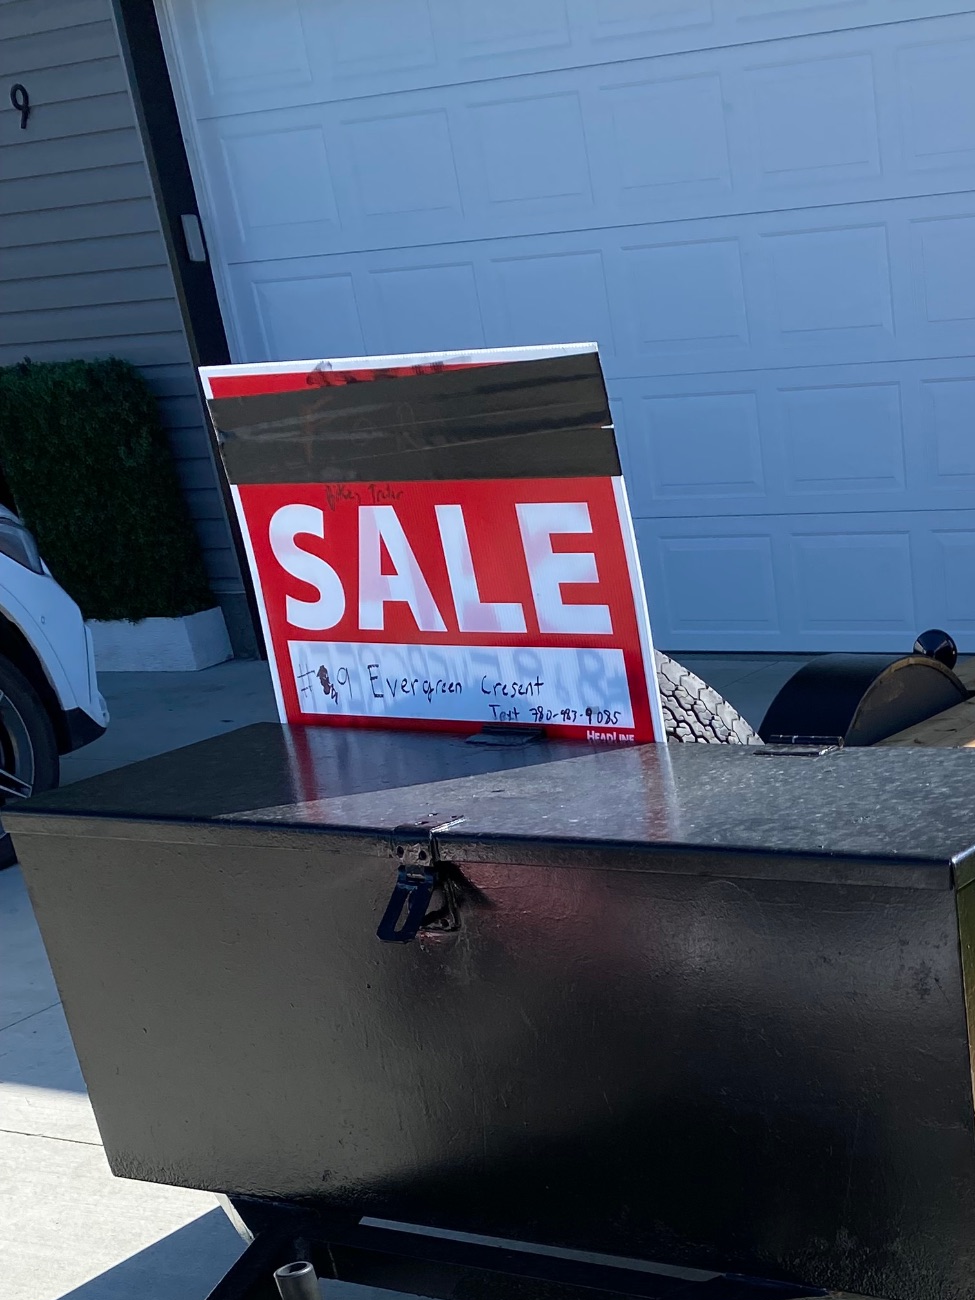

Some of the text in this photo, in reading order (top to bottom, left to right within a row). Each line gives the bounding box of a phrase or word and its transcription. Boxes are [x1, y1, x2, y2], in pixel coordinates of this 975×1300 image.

[10, 83, 30, 129] 9
[269, 502, 613, 634] SALE
[367, 664, 463, 703] Evergreen
[481, 675, 544, 698] Cresent
[489, 704, 520, 721] Text
